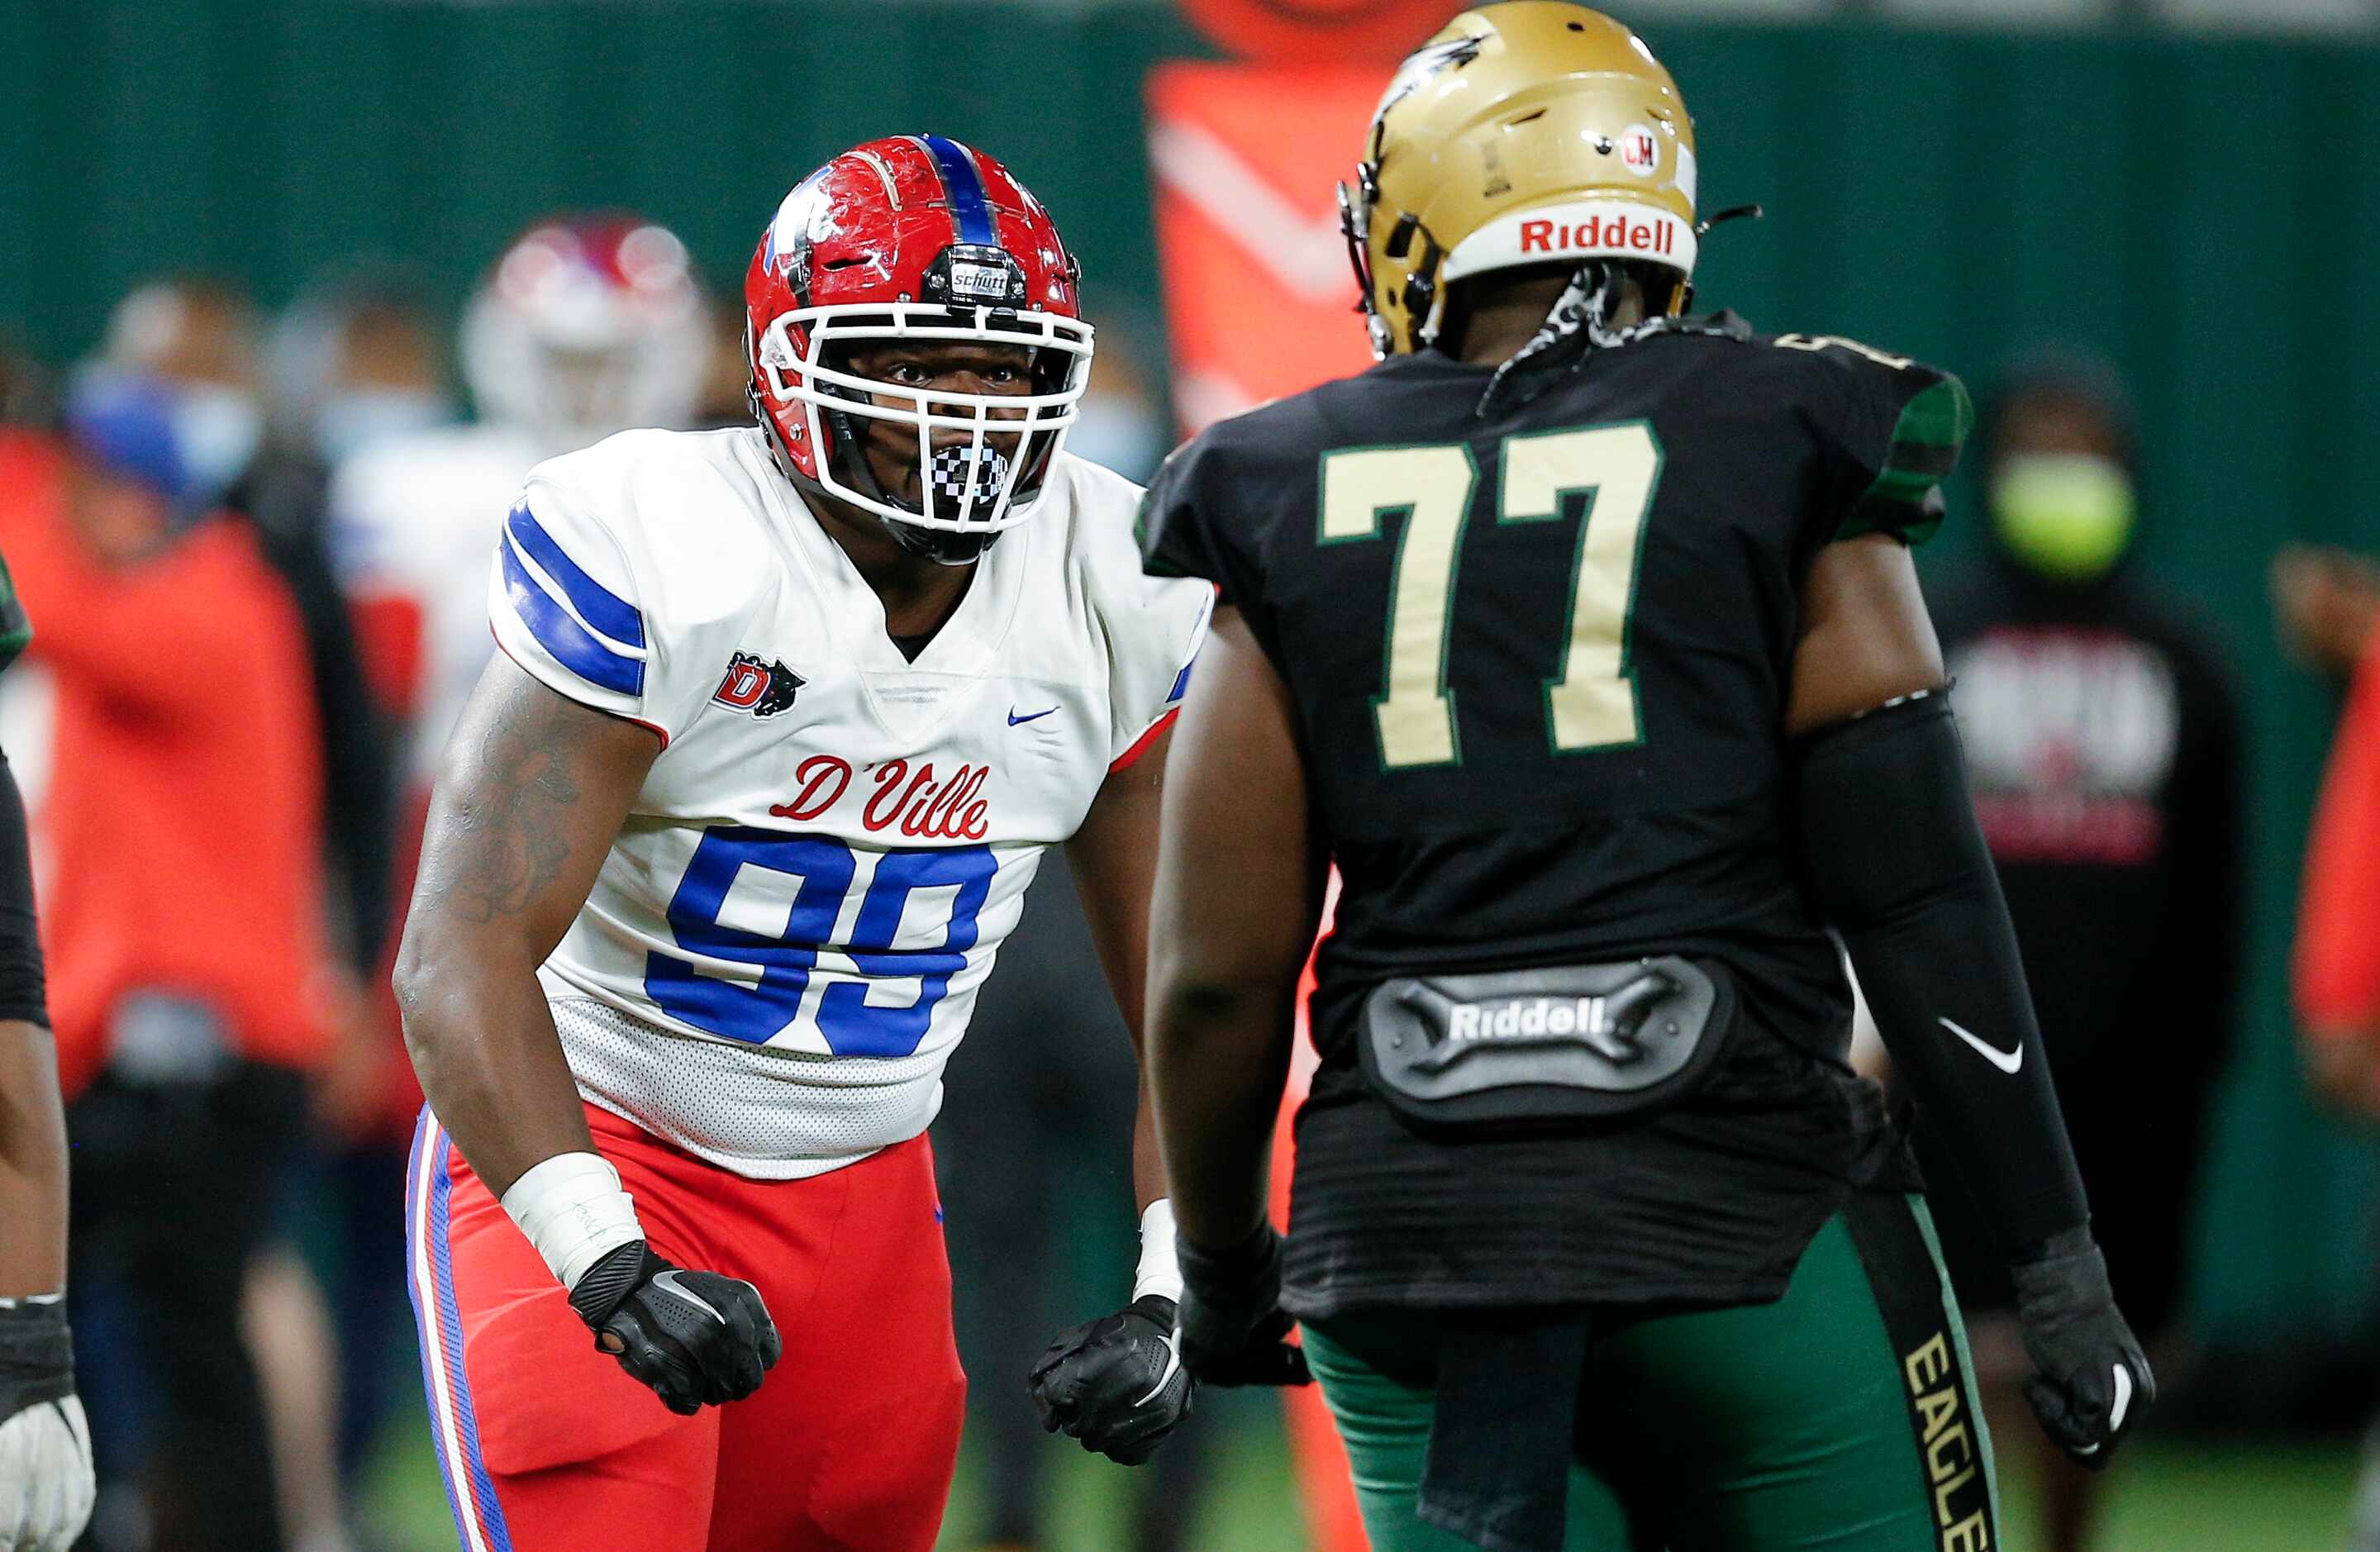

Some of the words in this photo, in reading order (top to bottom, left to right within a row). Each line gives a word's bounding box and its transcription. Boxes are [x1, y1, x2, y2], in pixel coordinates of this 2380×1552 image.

[954, 274, 1005, 289] schutt
[1521, 217, 1673, 255] Riddell
[1316, 418, 1665, 773] 77
[644, 826, 998, 1057] 99
[1449, 997, 1606, 1040] Riddell
[1905, 1331, 1987, 1552] EAGLE
